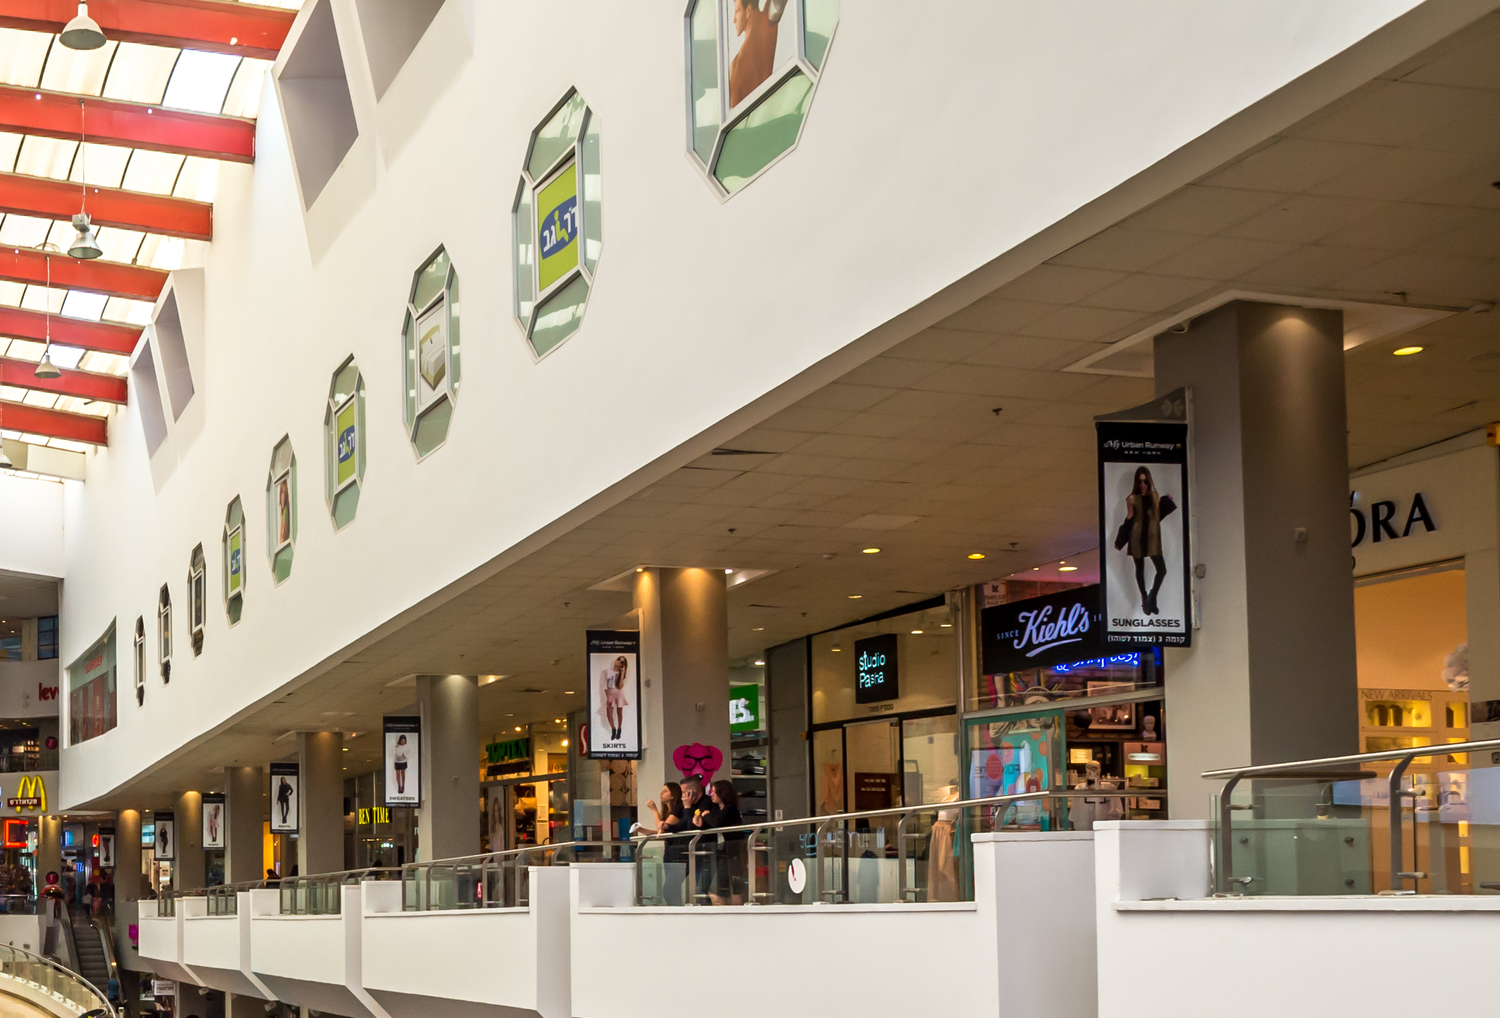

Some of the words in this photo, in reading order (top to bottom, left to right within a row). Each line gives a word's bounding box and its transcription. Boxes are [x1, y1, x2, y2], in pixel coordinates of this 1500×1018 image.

[1121, 441, 1144, 449] Urban
[1145, 442, 1174, 451] Runway
[1013, 602, 1090, 650] Kiehl's
[1112, 618, 1181, 629] SUNGLASSES
[996, 629, 1020, 641] SINCE
[1165, 635, 1186, 644] קומה
[858, 650, 886, 672] studio
[859, 671, 885, 689] Pasha
[1361, 690, 1387, 700] NEW
[1388, 690, 1433, 701] ARRIVALS
[602, 742, 627, 750] SKIRTS
[358, 808, 370, 825] BEN
[373, 806, 390, 824] TIME
